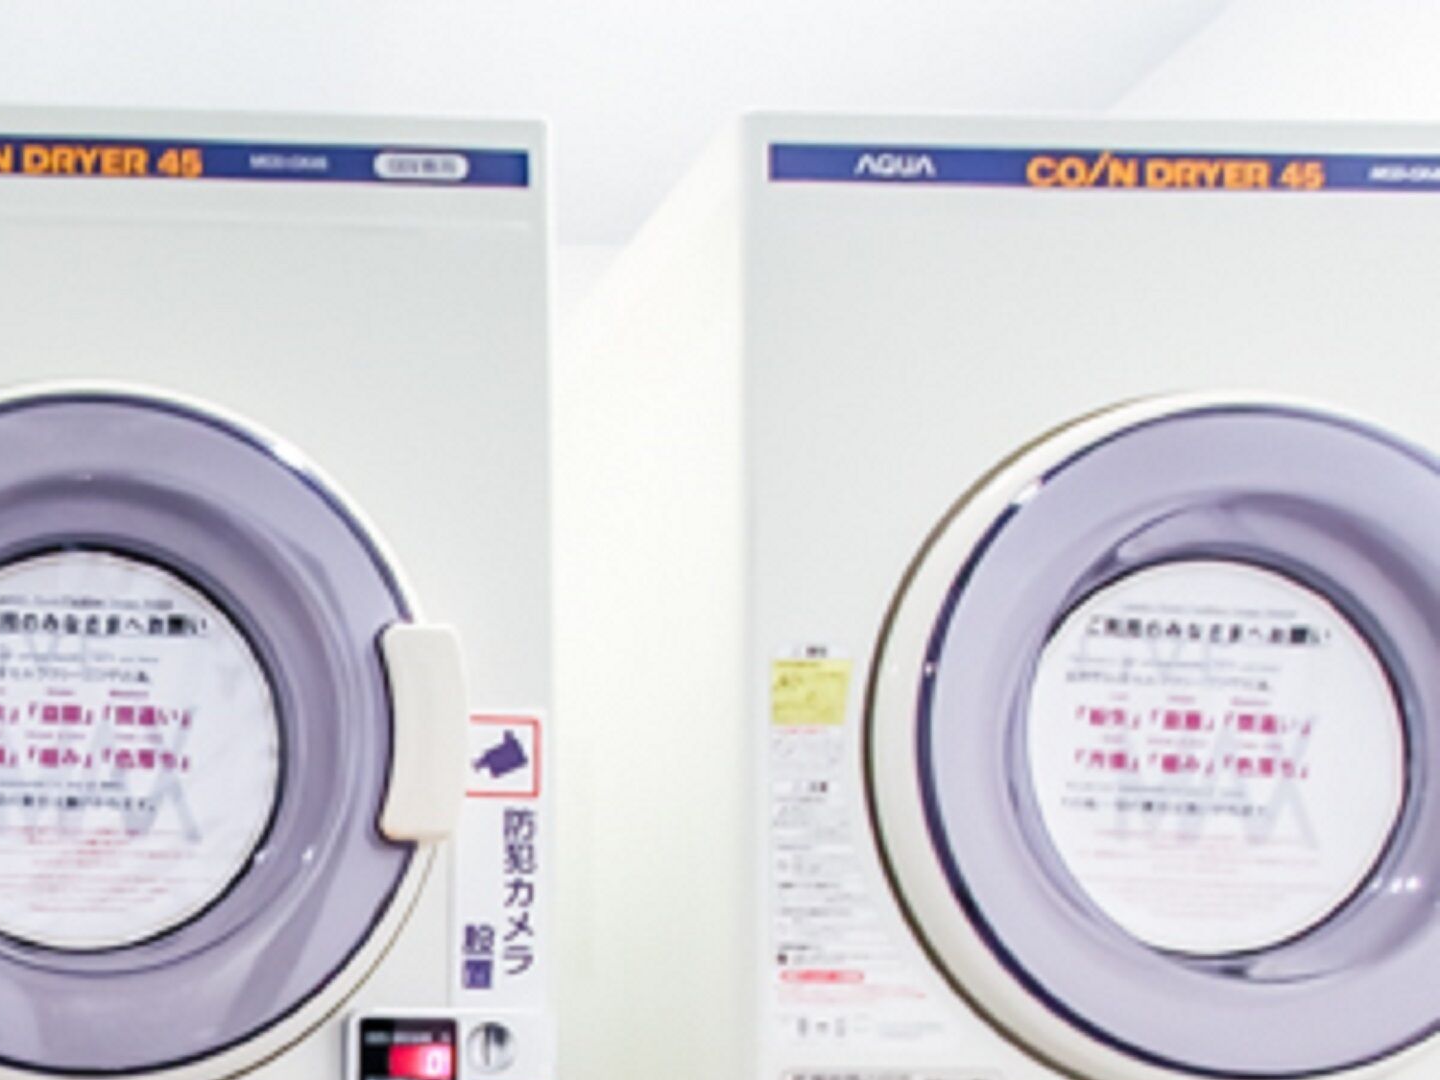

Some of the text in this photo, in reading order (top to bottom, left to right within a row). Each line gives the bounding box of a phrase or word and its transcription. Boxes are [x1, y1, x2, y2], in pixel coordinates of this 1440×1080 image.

[22, 144, 149, 176] DRYER
[157, 148, 203, 178] 45
[855, 154, 935, 178] AQUA
[1026, 150, 1323, 190] COIN DRYER 45
[503, 807, 537, 975] 防犯カメラ
